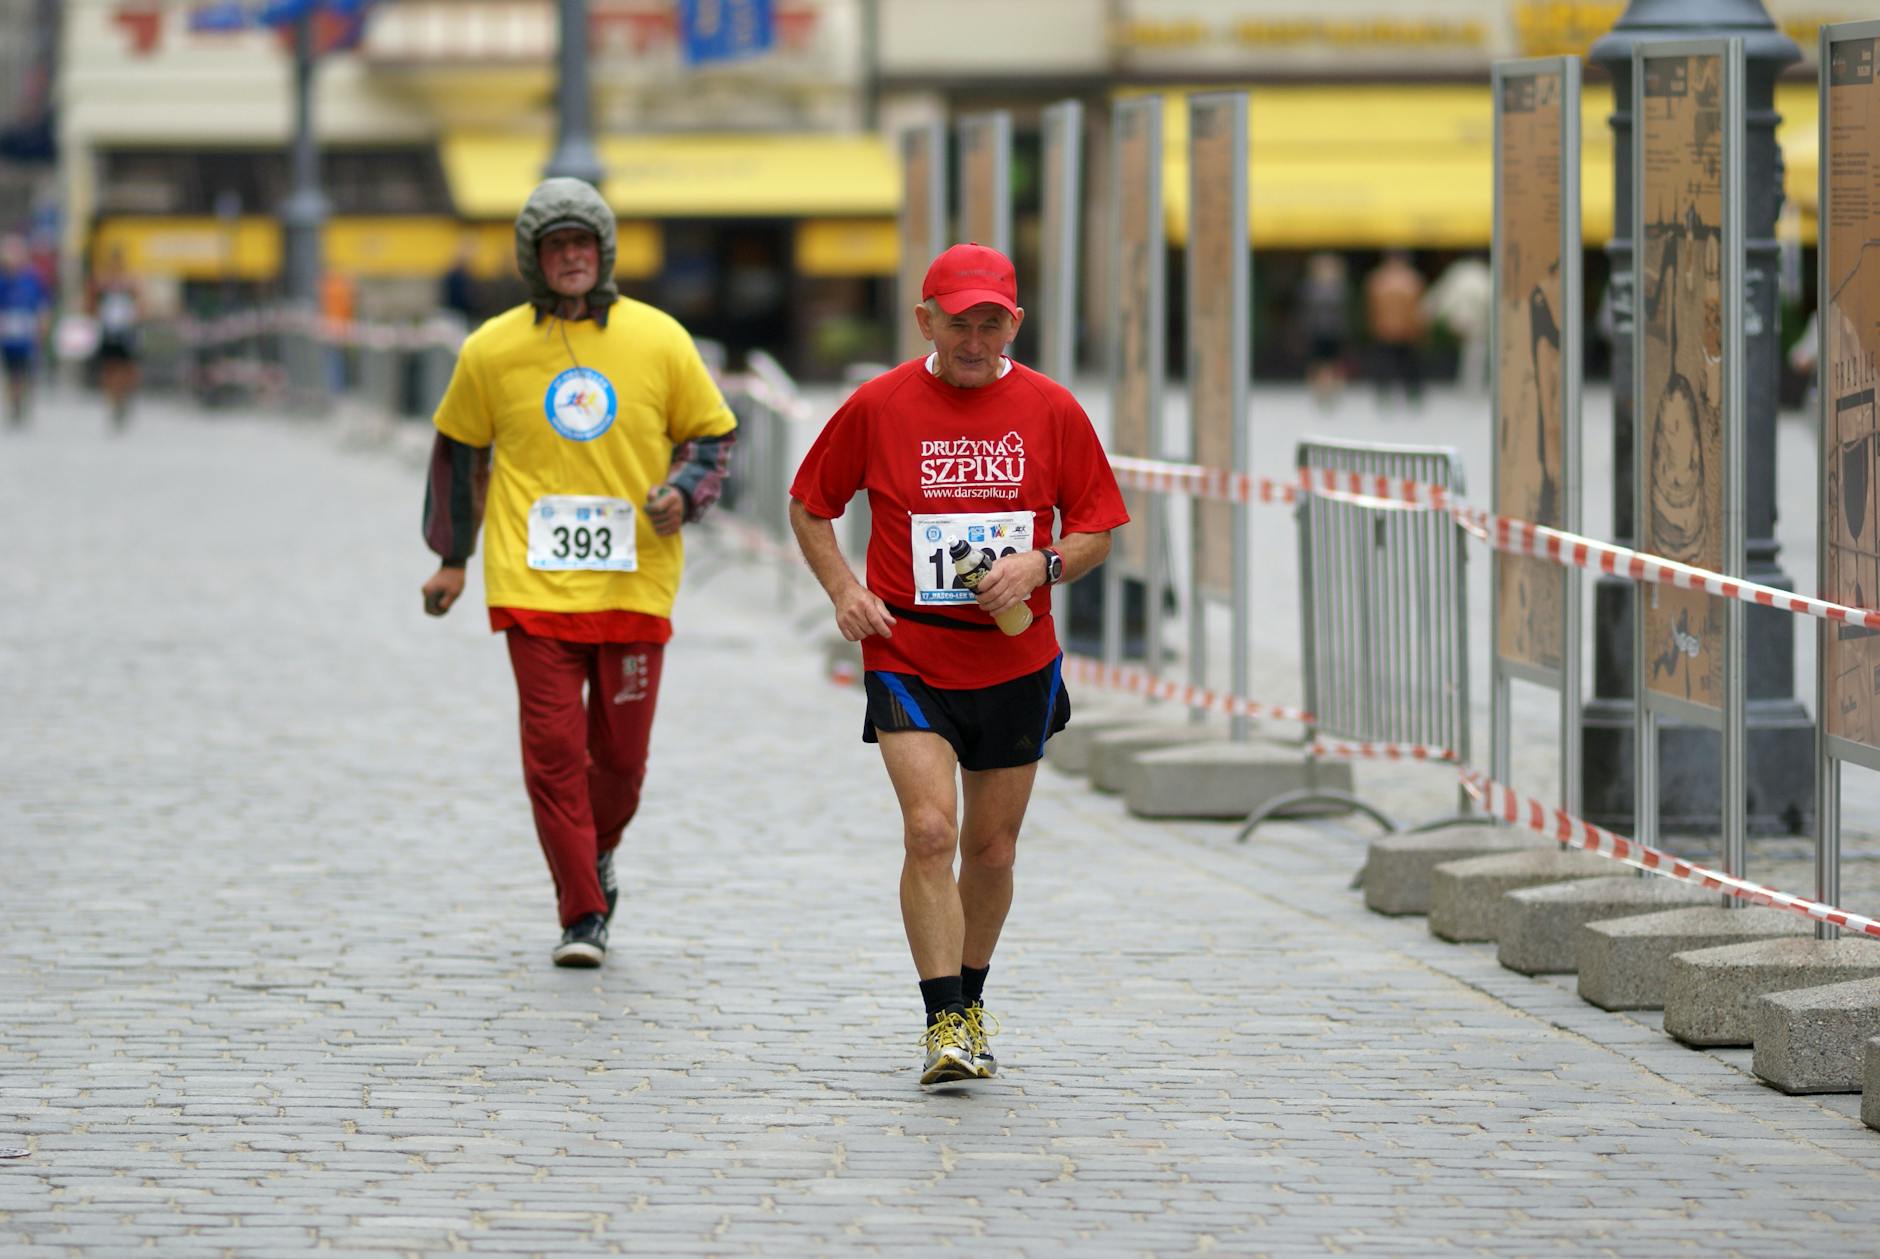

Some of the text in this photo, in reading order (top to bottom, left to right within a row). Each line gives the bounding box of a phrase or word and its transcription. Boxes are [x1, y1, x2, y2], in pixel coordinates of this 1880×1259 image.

[921, 436, 1008, 456] DRUŻYNA
[921, 456, 1025, 485] SZPIKU
[923, 487, 1018, 500] www.darszpiku.pl
[552, 526, 612, 560] 393
